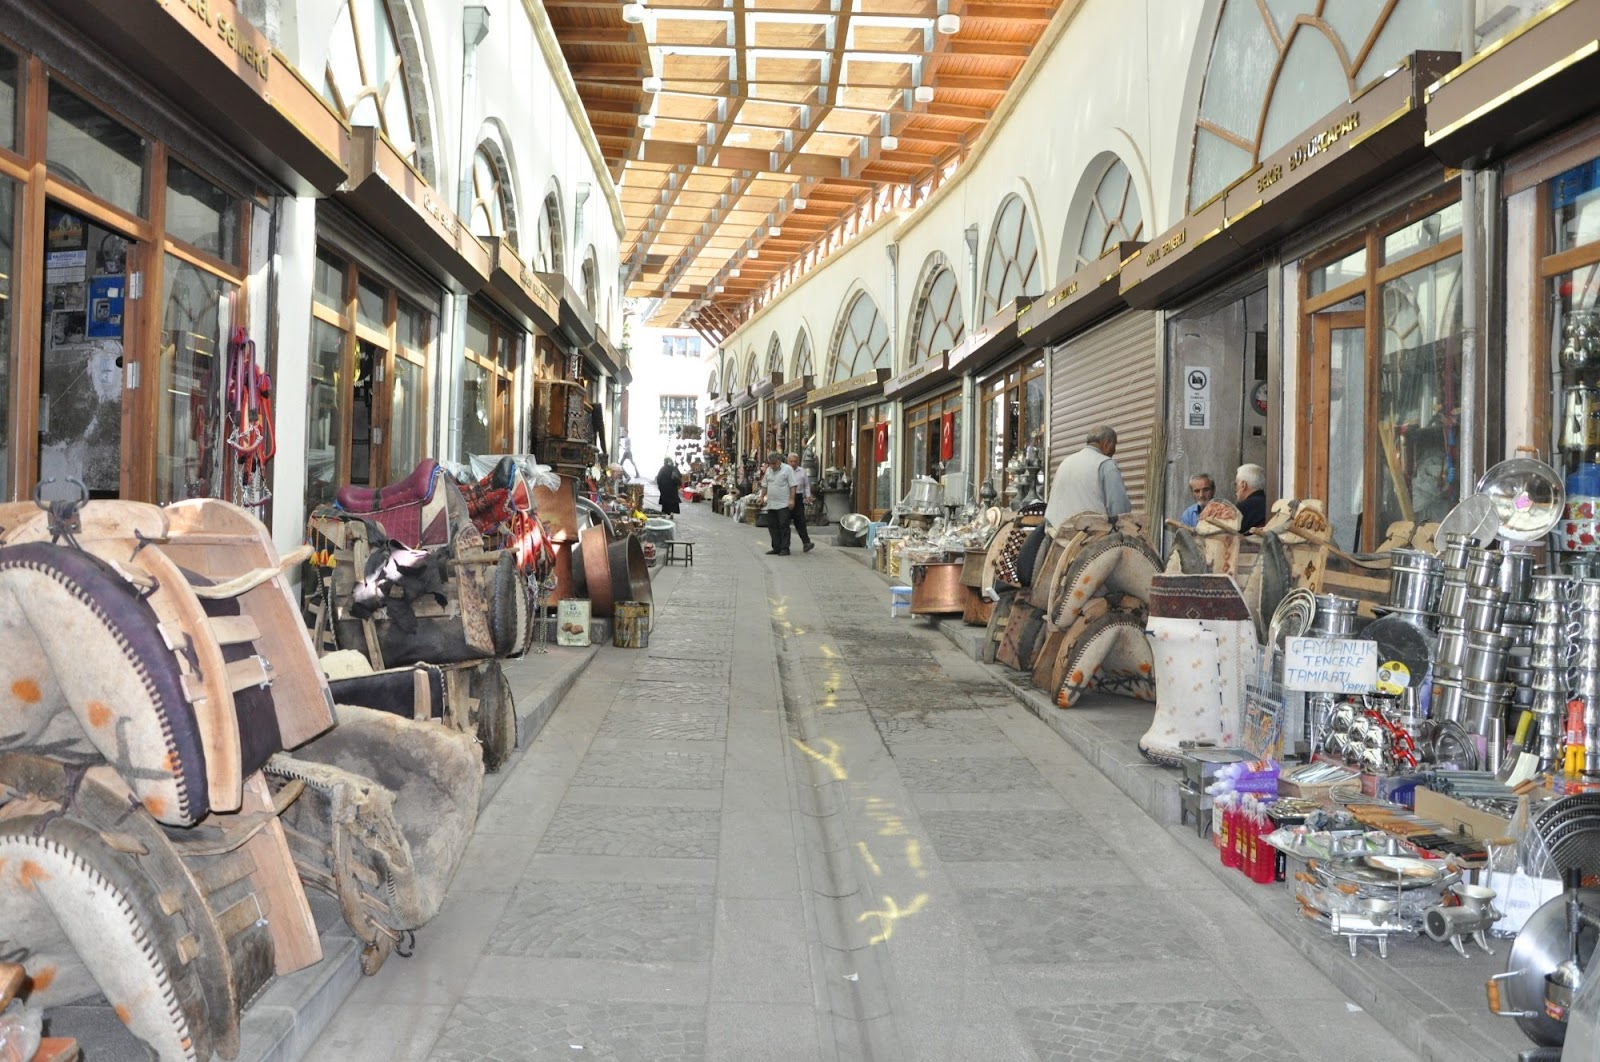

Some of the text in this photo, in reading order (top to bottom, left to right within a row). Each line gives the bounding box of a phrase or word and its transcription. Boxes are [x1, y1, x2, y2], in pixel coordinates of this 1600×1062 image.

[1288, 111, 1360, 171] BÜYÜKÇAPAR
[1292, 640, 1376, 655] ÇAYDANLIK
[1303, 655, 1365, 668] TENCERE
